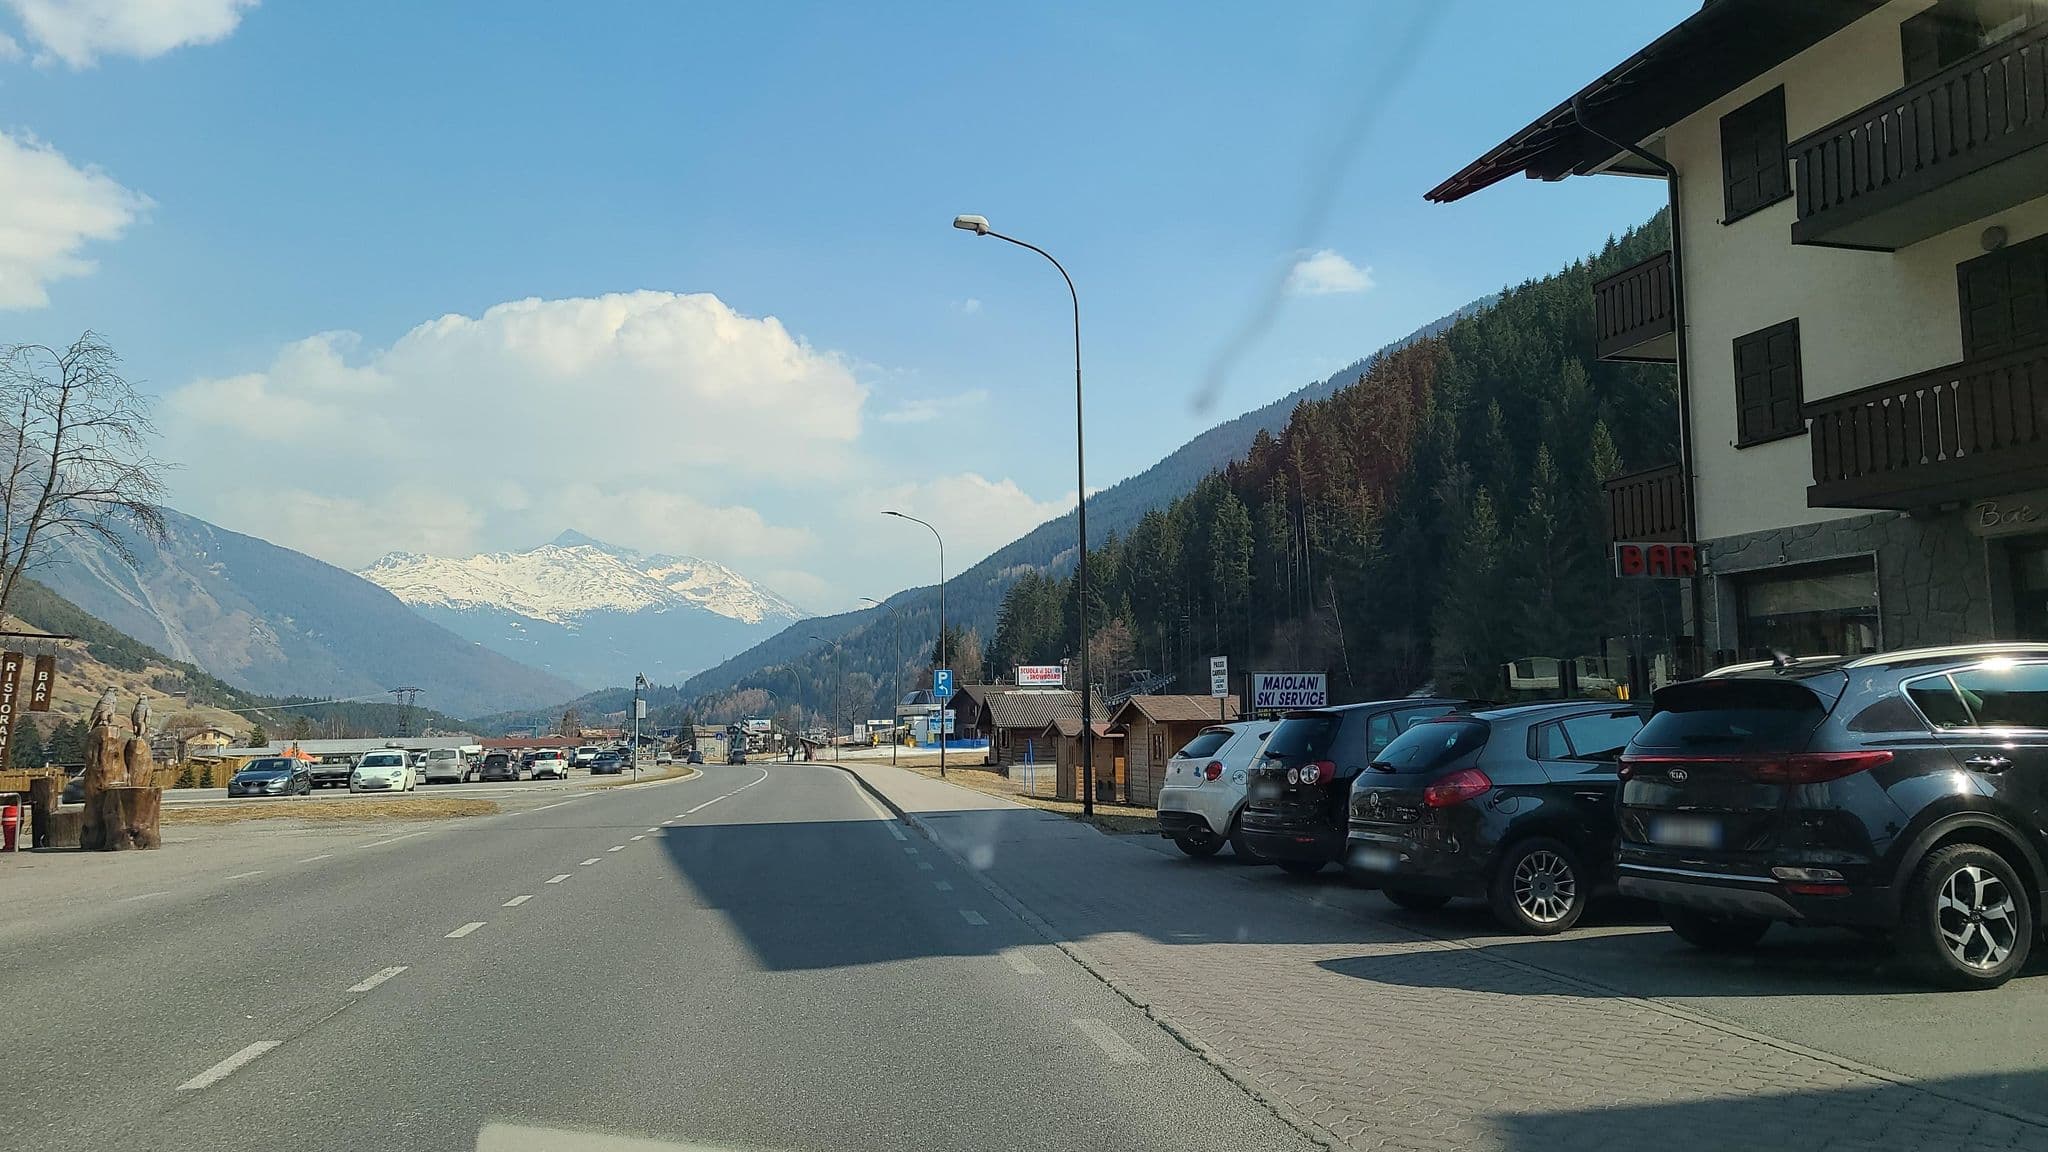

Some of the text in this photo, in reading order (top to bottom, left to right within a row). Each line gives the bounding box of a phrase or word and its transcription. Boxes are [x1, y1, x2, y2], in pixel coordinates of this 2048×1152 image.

[1620, 544, 1695, 576] BAR
[938, 671, 948, 684] P
[1262, 676, 1319, 690] MAIOLANI
[35, 671, 49, 702] BAR
[1257, 691, 1325, 706] SKI SERVICE
